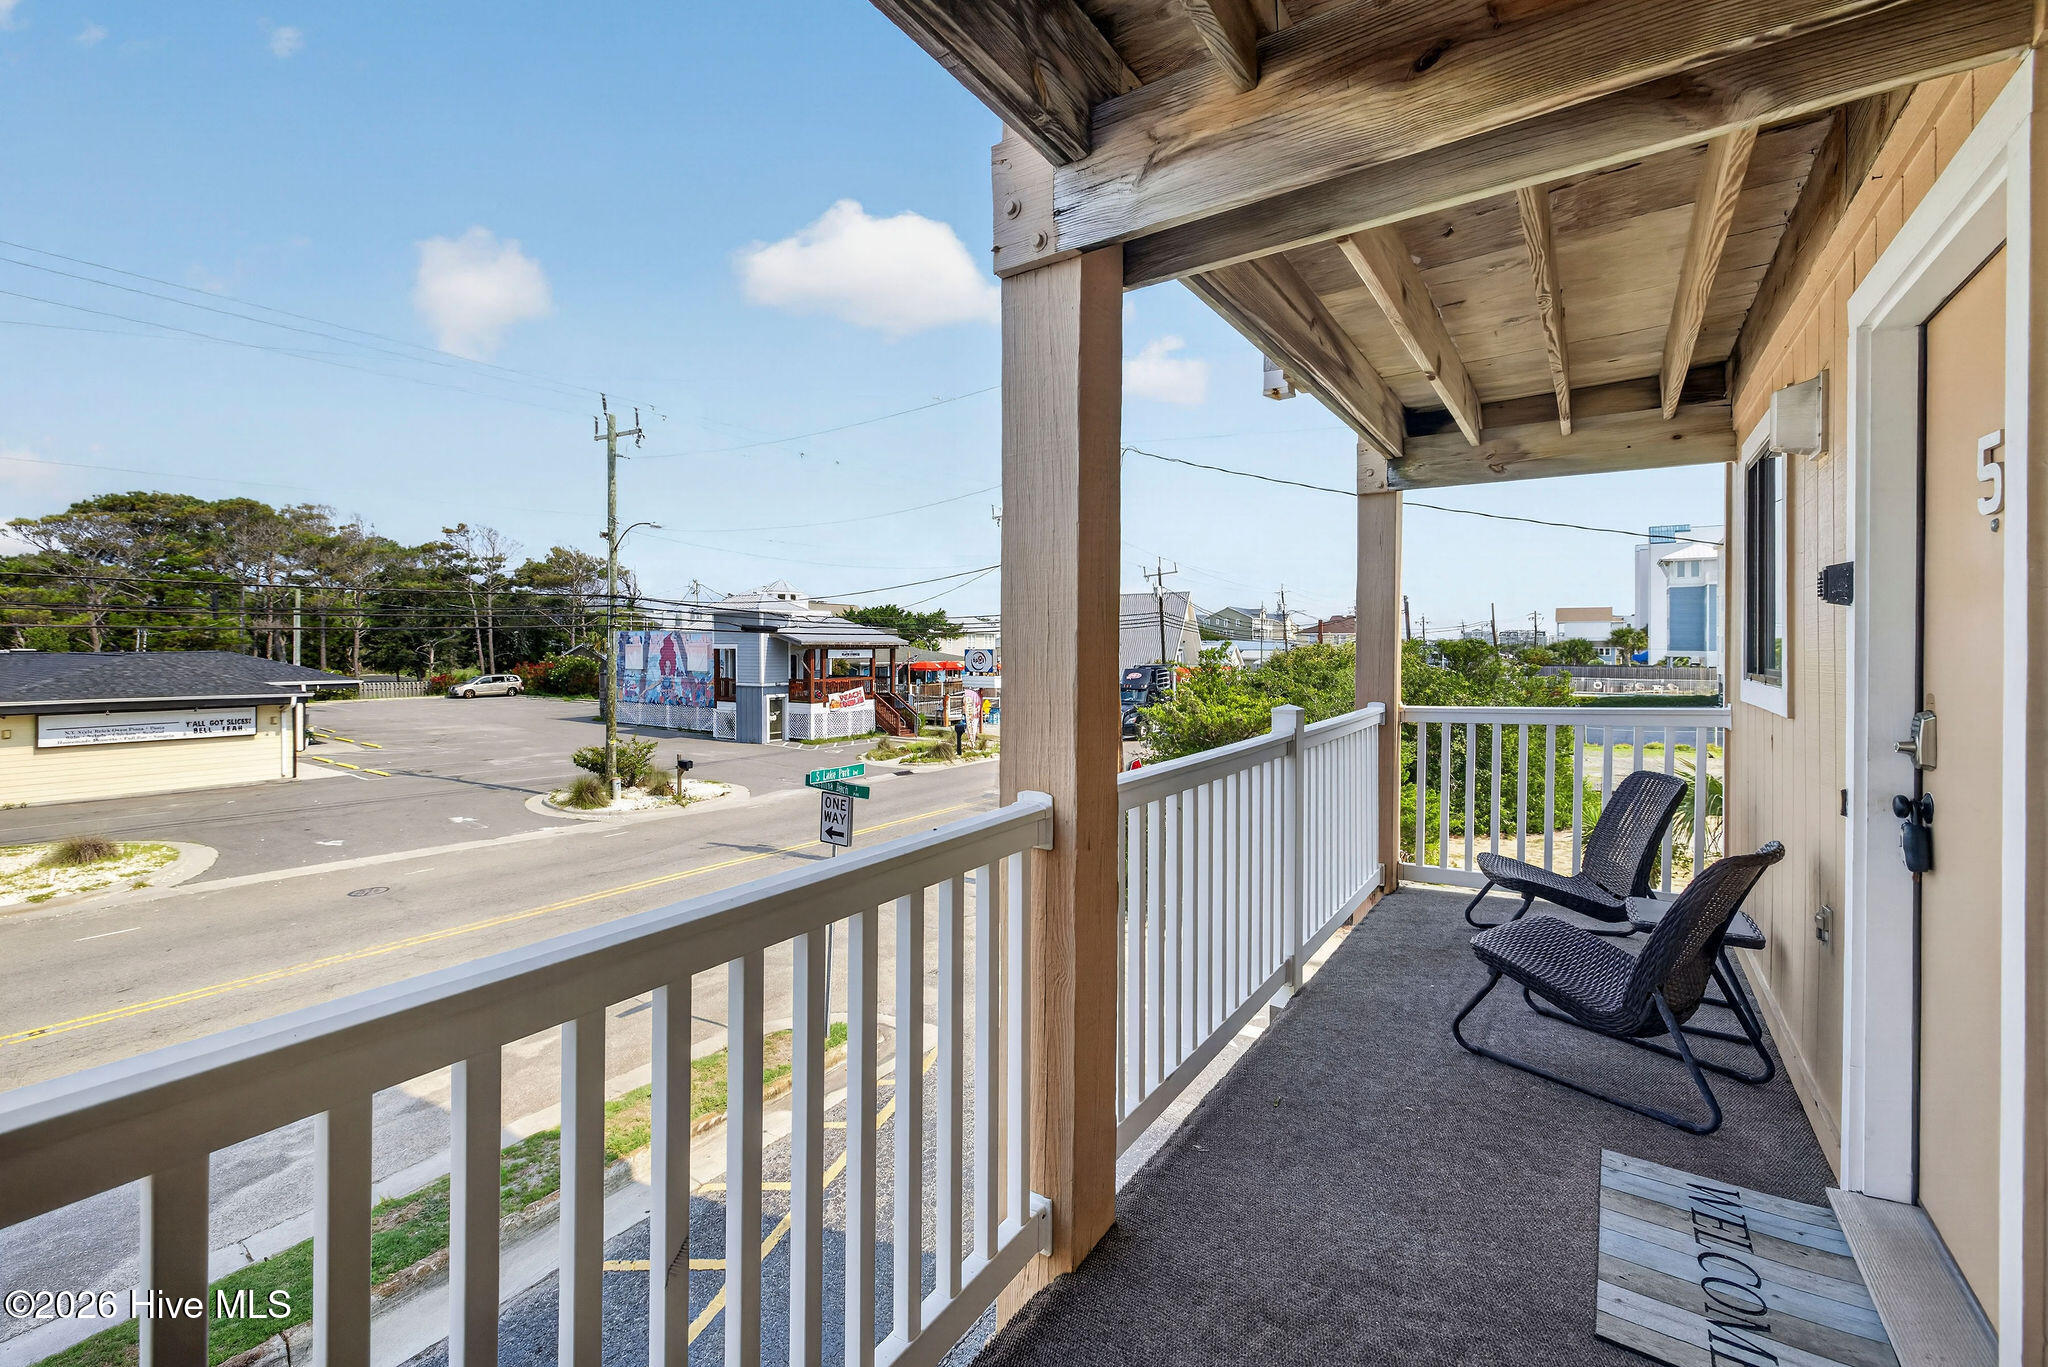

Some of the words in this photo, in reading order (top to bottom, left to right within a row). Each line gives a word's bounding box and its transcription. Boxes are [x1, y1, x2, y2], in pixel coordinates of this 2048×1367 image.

[1977, 430, 2001, 515] 5
[186, 720, 206, 728] Y'ALL
[816, 771, 820, 782] S
[823, 769, 837, 781] Lake
[839, 767, 850, 778] Park
[825, 797, 847, 811] ONE
[824, 810, 847, 825] WAY
